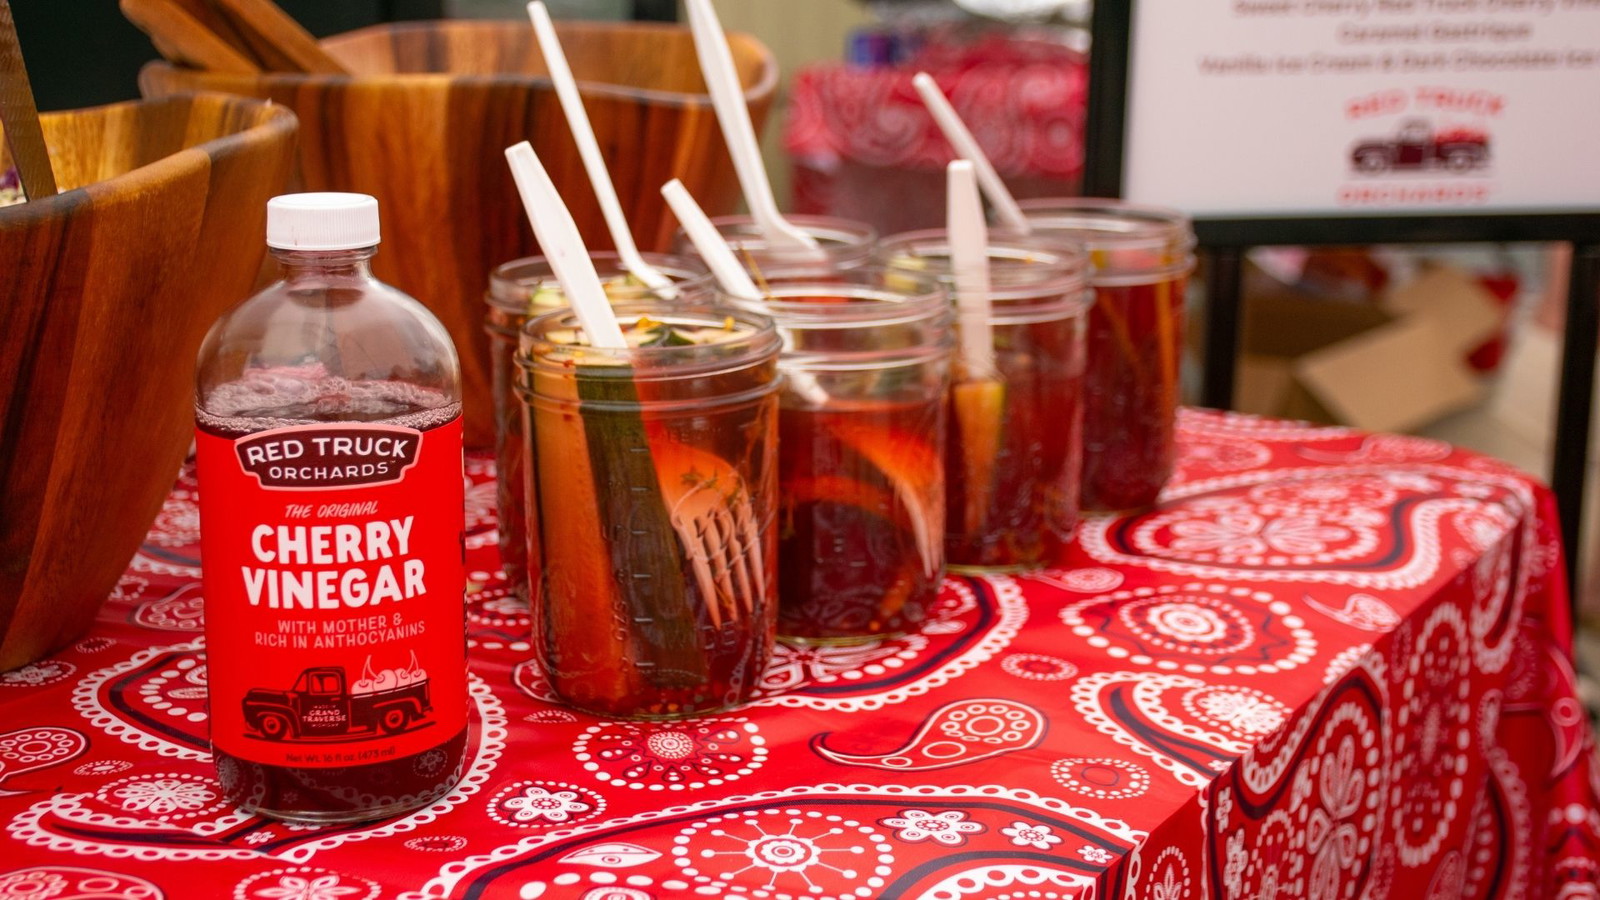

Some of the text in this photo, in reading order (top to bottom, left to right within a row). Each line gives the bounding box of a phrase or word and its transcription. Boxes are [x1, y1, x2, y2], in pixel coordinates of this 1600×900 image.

[1346, 88, 1506, 118] RED TRUCK
[246, 437, 409, 466] RED TRUCK
[284, 501, 379, 518] THE ORIGINAL
[251, 515, 414, 564] CHERRY
[241, 559, 427, 609] VINEGAR
[255, 620, 426, 648] RICH IN ANTHOCYANINS
[277, 612, 403, 634] WITH MOTHER &
[302, 714, 347, 722] TRAVERSE
[285, 753, 302, 762] Net
